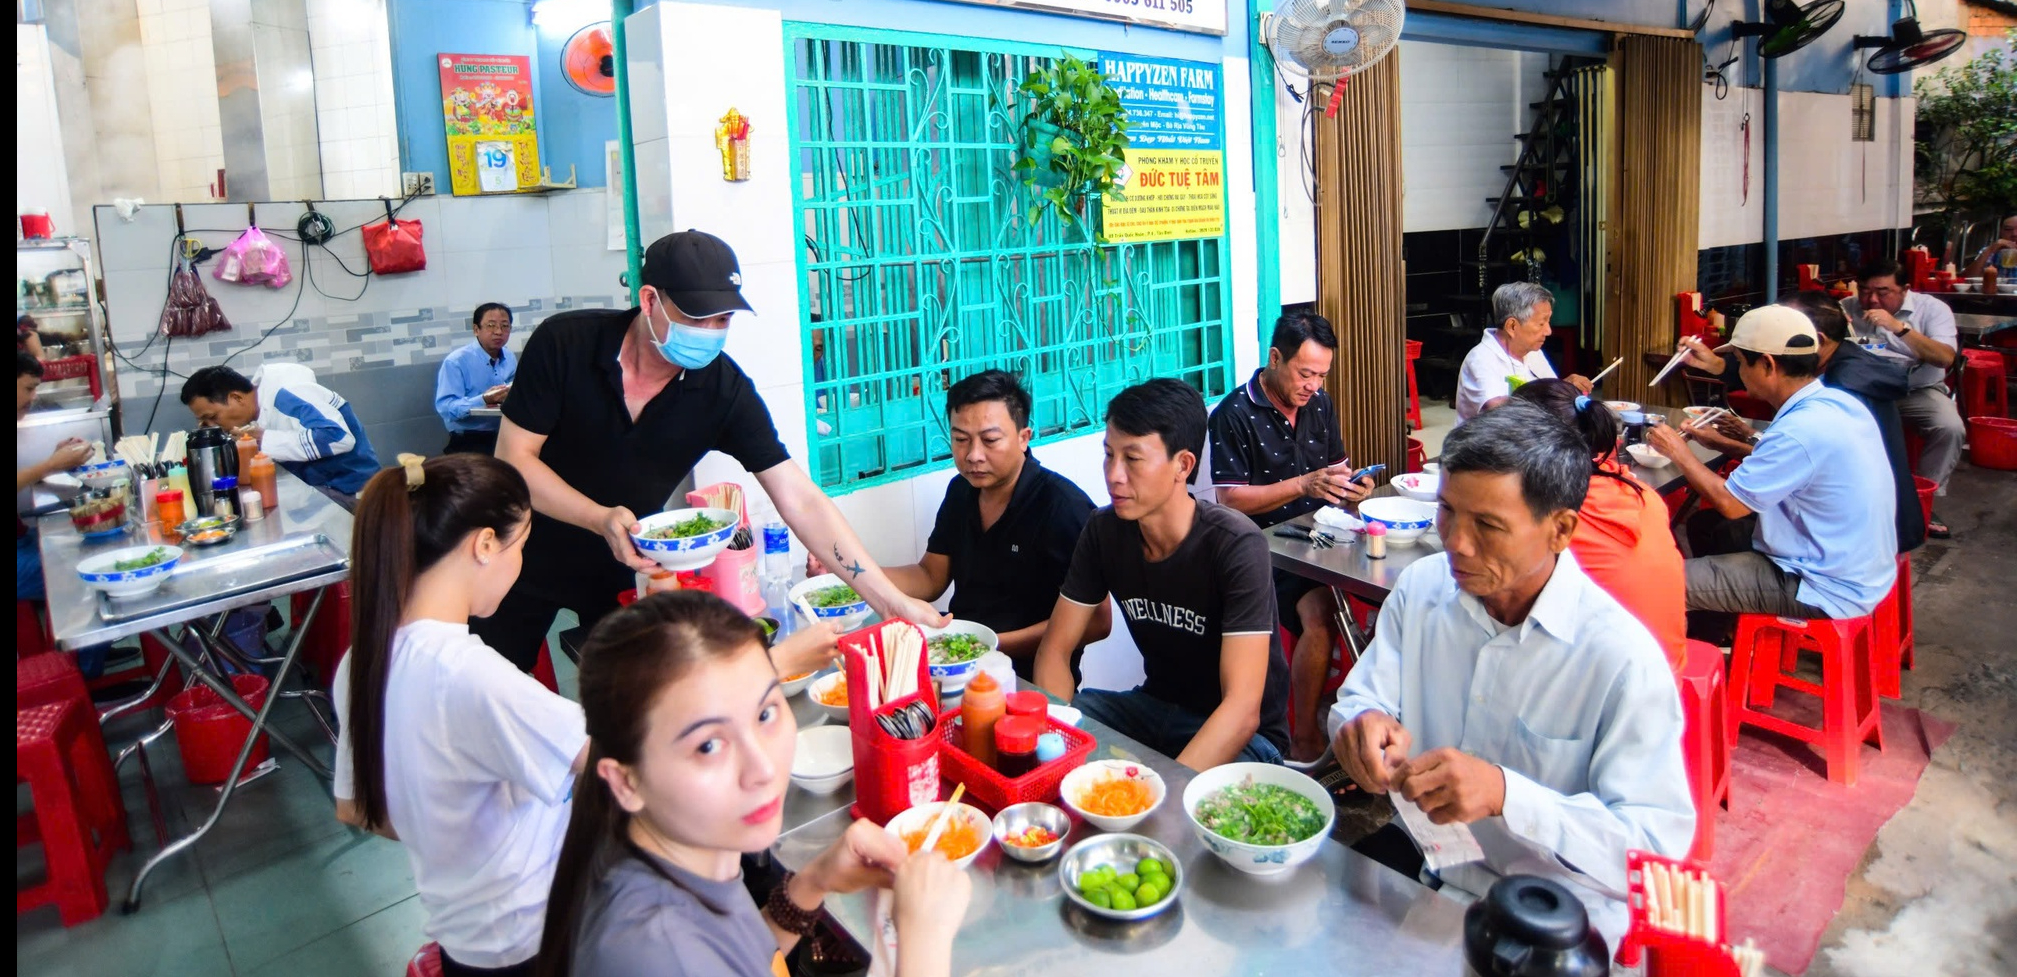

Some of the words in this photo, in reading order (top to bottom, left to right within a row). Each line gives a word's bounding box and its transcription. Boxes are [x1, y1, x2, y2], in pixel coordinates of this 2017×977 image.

[1170, 0, 1193, 14] 505
[478, 65, 519, 75] PASTEUR
[1104, 59, 1178, 87] HAPPYZEN
[1180, 67, 1214, 90] FARM
[483, 149, 507, 169] 19
[1174, 157, 1179, 165] Y
[1139, 168, 1166, 187] ĐỨC
[1168, 168, 1191, 190] TUỆ
[1195, 168, 1219, 186] TÂM
[1121, 597, 1207, 636] WELLNESS
